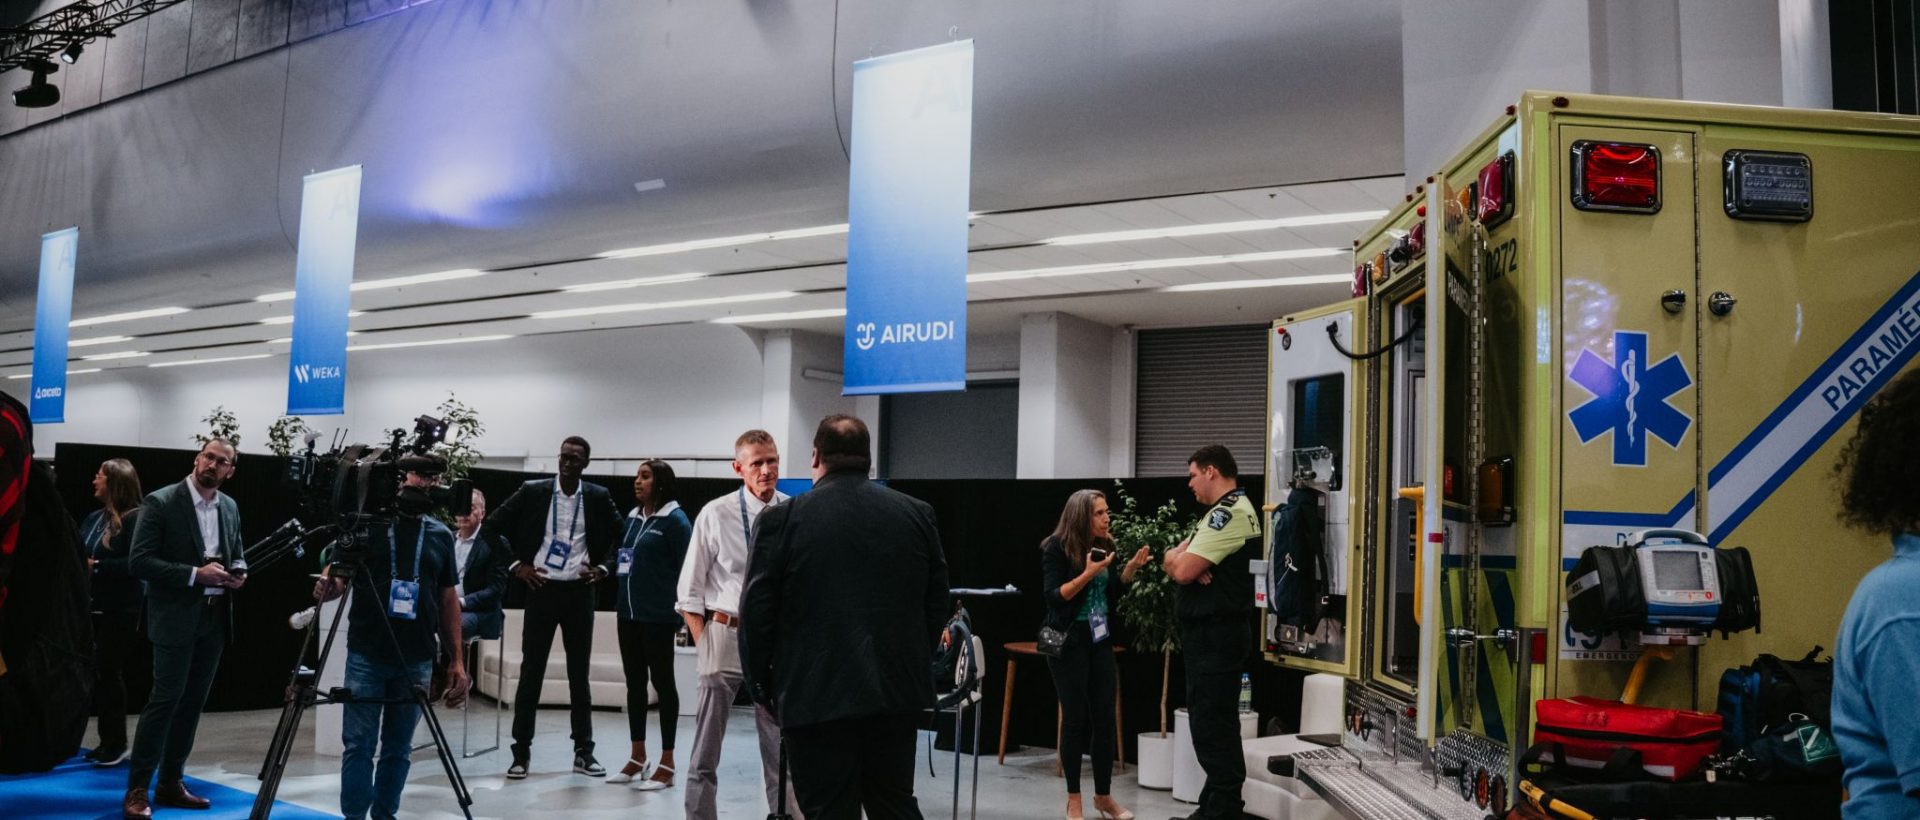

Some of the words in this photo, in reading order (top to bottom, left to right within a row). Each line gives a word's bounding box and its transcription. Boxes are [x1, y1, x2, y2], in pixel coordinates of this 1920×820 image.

[880, 320, 954, 344] AIRUDI
[1821, 300, 1920, 412] PARAMÉ
[312, 366, 340, 379] WEKA
[1575, 652, 1636, 660] EMERGENC
